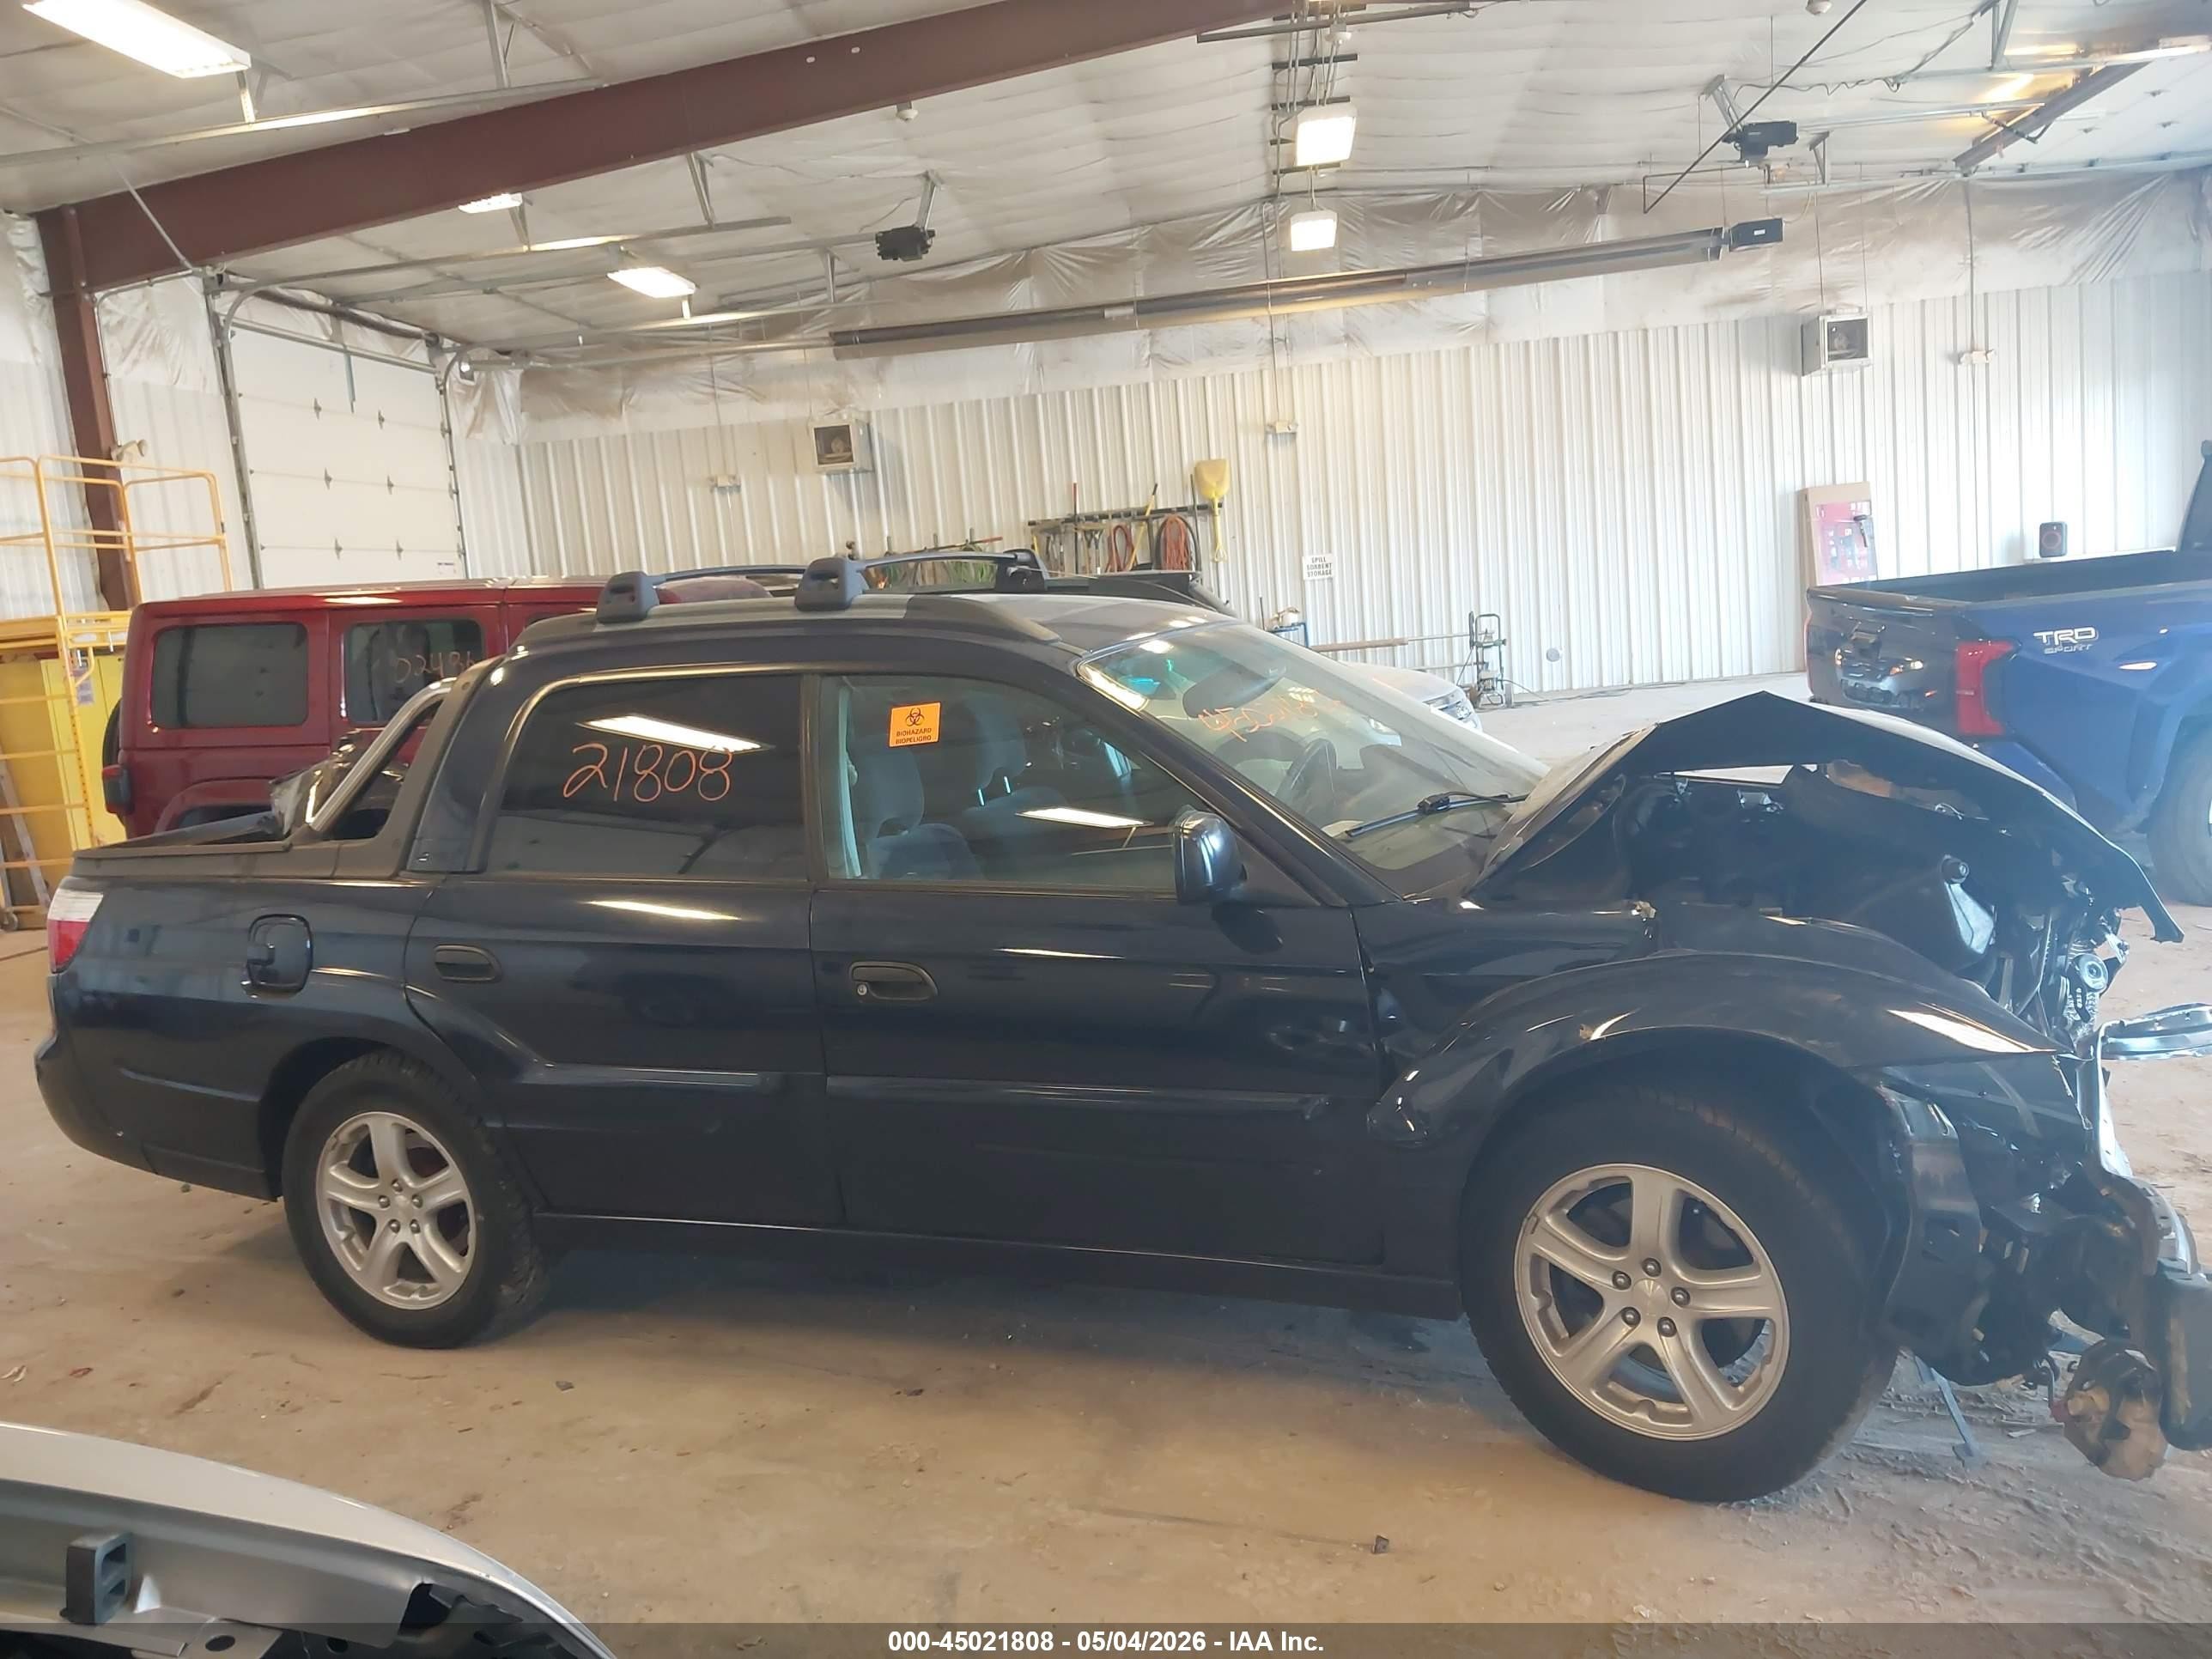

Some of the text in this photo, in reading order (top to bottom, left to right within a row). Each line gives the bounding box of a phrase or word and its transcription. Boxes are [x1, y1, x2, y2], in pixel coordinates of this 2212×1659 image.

[2033, 627, 2097, 646] TRD
[2045, 643, 2093, 654] SPORT
[896, 727, 932, 737] BIOHAZARD
[896, 735, 932, 744] BIOPELIGRO
[562, 742, 734, 803] 21808
